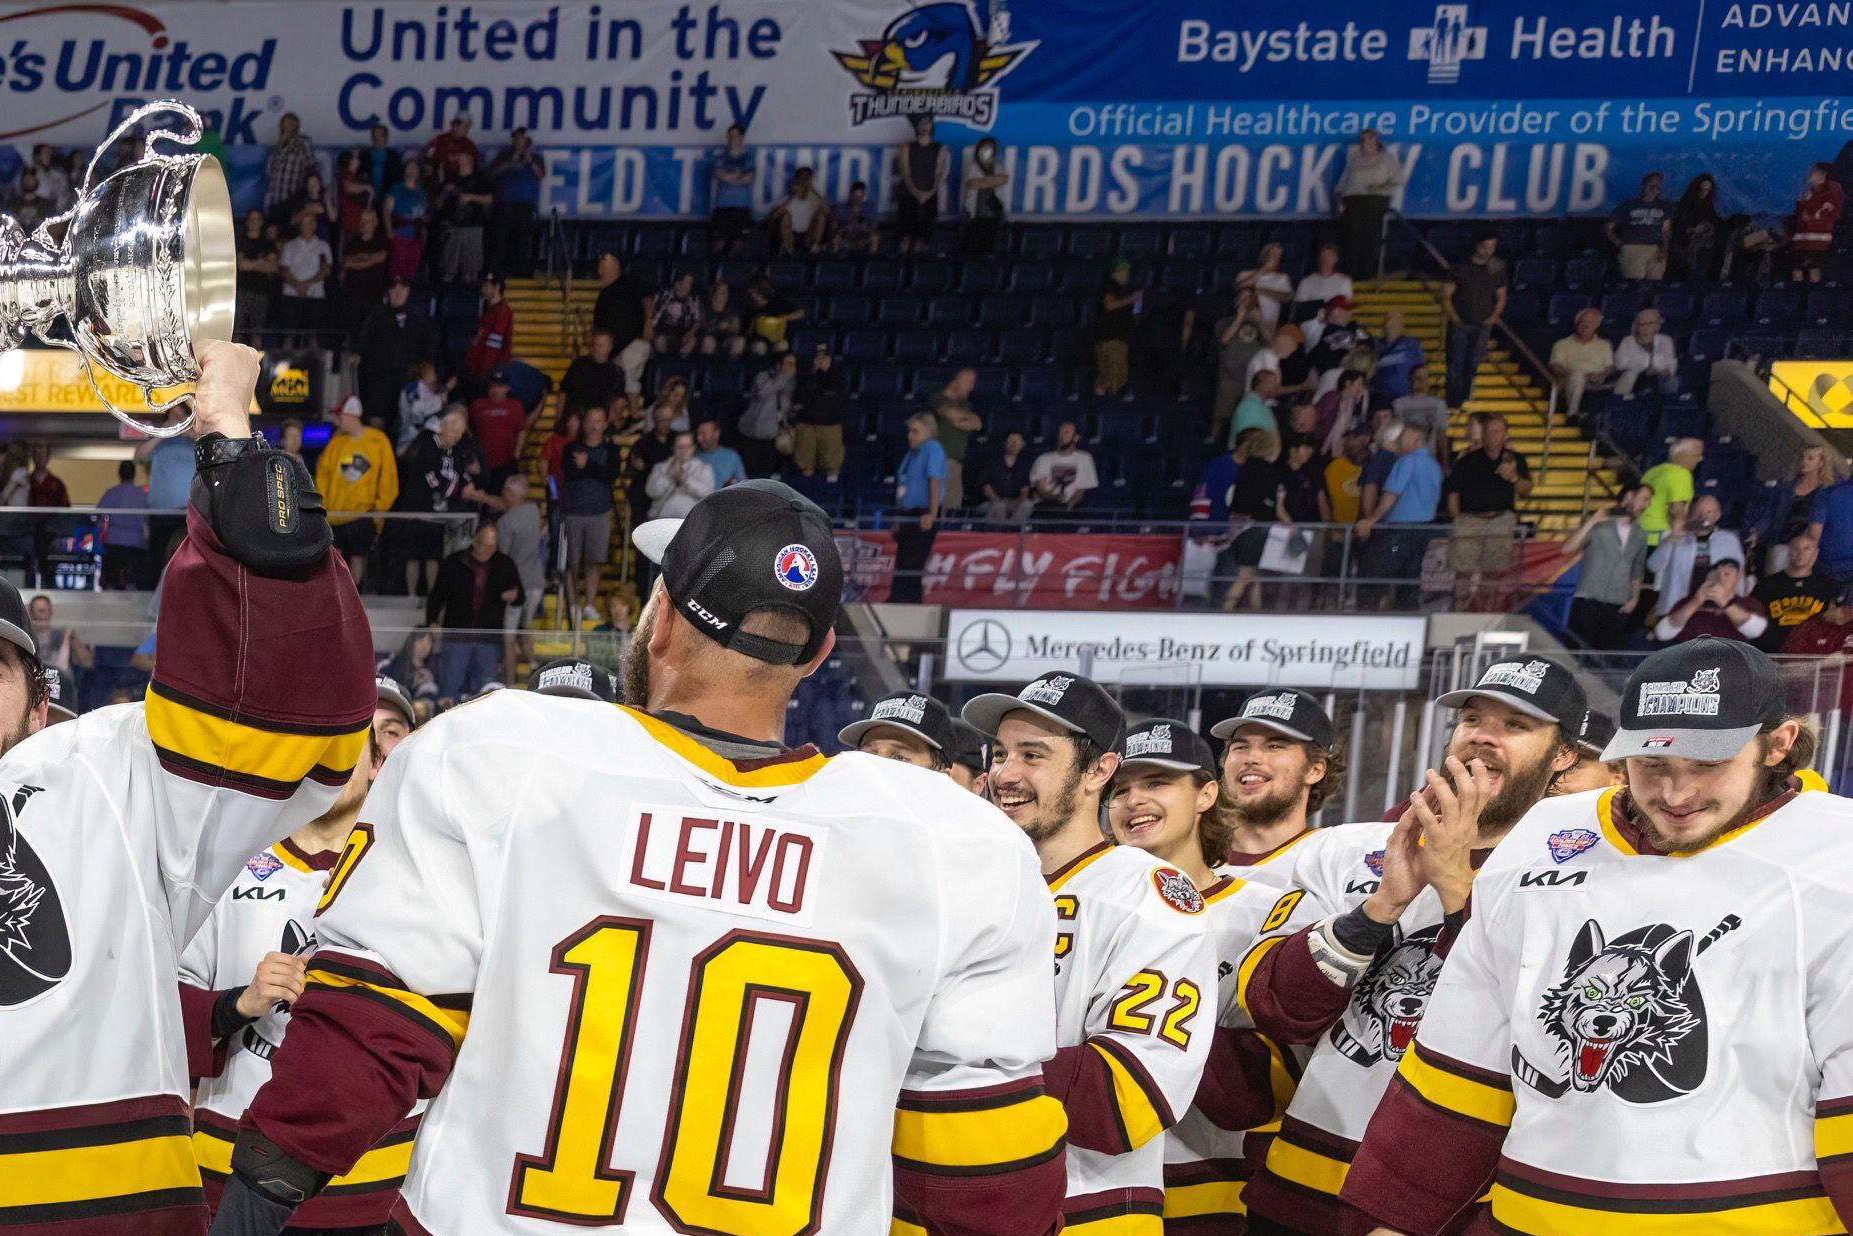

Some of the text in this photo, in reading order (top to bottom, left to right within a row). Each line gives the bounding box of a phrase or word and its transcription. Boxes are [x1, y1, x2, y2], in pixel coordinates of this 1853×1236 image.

[341, 5, 782, 61] United in the
[1178, 16, 1676, 72] Baystate Health
[55, 38, 277, 92] United
[338, 70, 767, 131] Community
[1068, 104, 1214, 137] Official
[1223, 103, 1396, 136] Healthcare
[1410, 102, 1561, 133] Provider
[1570, 102, 1612, 133] of
[1621, 102, 1680, 133] the
[1169, 142, 1425, 214] HOCKY
[1449, 142, 1610, 213] CLUB
[687, 598, 729, 630] CCM
[1026, 633, 1411, 670] Mercedes-Benz of Springfield
[629, 812, 814, 915] LEIVO
[1105, 967, 1202, 1052] 22
